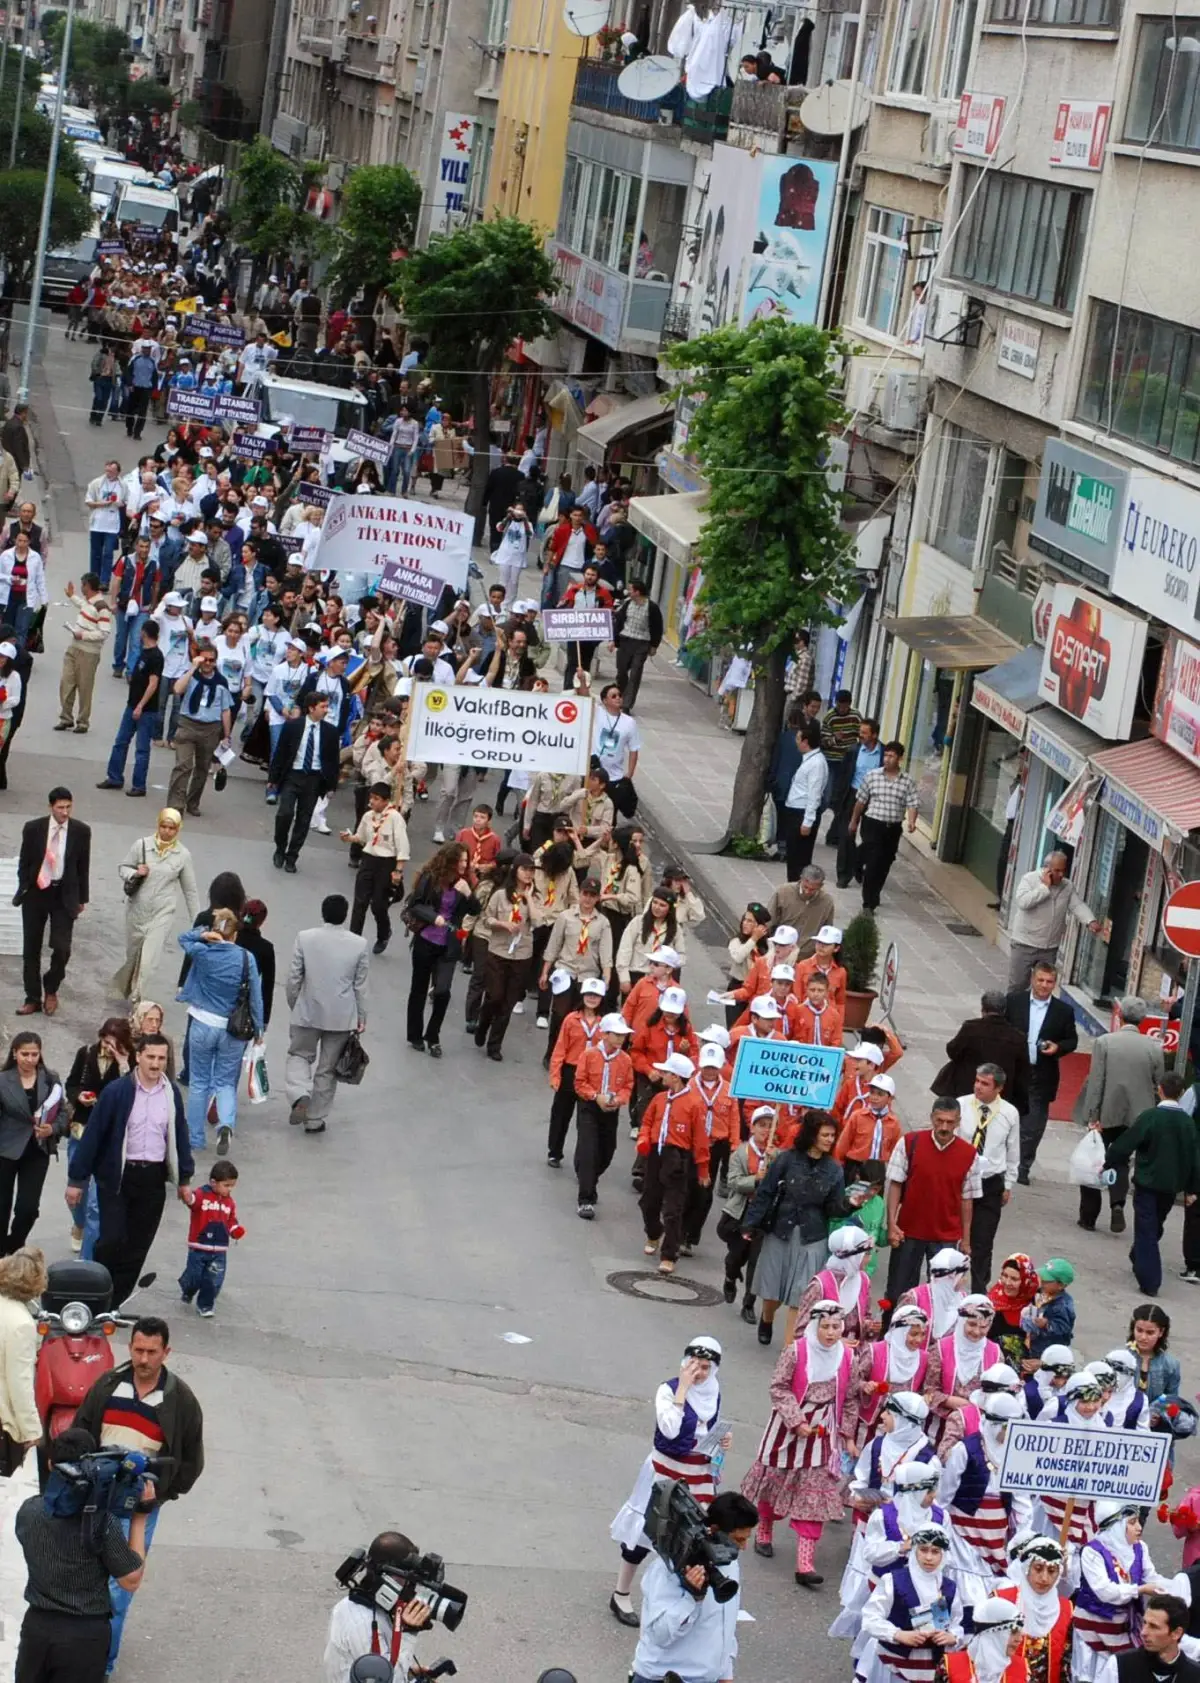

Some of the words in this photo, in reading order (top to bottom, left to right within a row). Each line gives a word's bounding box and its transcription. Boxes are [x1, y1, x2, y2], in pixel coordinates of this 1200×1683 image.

[177, 393, 210, 407] TRABZON
[220, 396, 255, 410] İSTANBUL
[241, 435, 266, 448] İTALYA
[352, 433, 388, 452] HOLLANDA
[348, 504, 408, 523] ANKARA
[412, 511, 464, 535] SANAT
[357, 524, 447, 550] TİYATROSU
[1141, 515, 1198, 573] EUREKO
[380, 577, 402, 594] SANAT
[393, 567, 433, 590] ANKARA
[551, 610, 605, 626] SIRBİSTAN
[1053, 630, 1107, 684] D-SMART
[453, 696, 549, 720] VakıfBank
[424, 716, 515, 744] İlköğretim
[521, 729, 575, 749] Okulu
[471, 749, 523, 763] ORDU
[760, 1049, 825, 1068] DURUGÖL
[749, 1061, 830, 1084] İLKÖĞRETİM
[764, 1081, 809, 1097] OKULU
[1014, 1433, 1060, 1454] ORDU
[1063, 1437, 1159, 1464] BELEDİYESİ
[1035, 1456, 1129, 1477] KONSERVATUVARI
[1005, 1471, 1034, 1486] HALK
[1036, 1474, 1088, 1491] OYUNLARI
[1091, 1479, 1152, 1498] TOPLULUĞU
